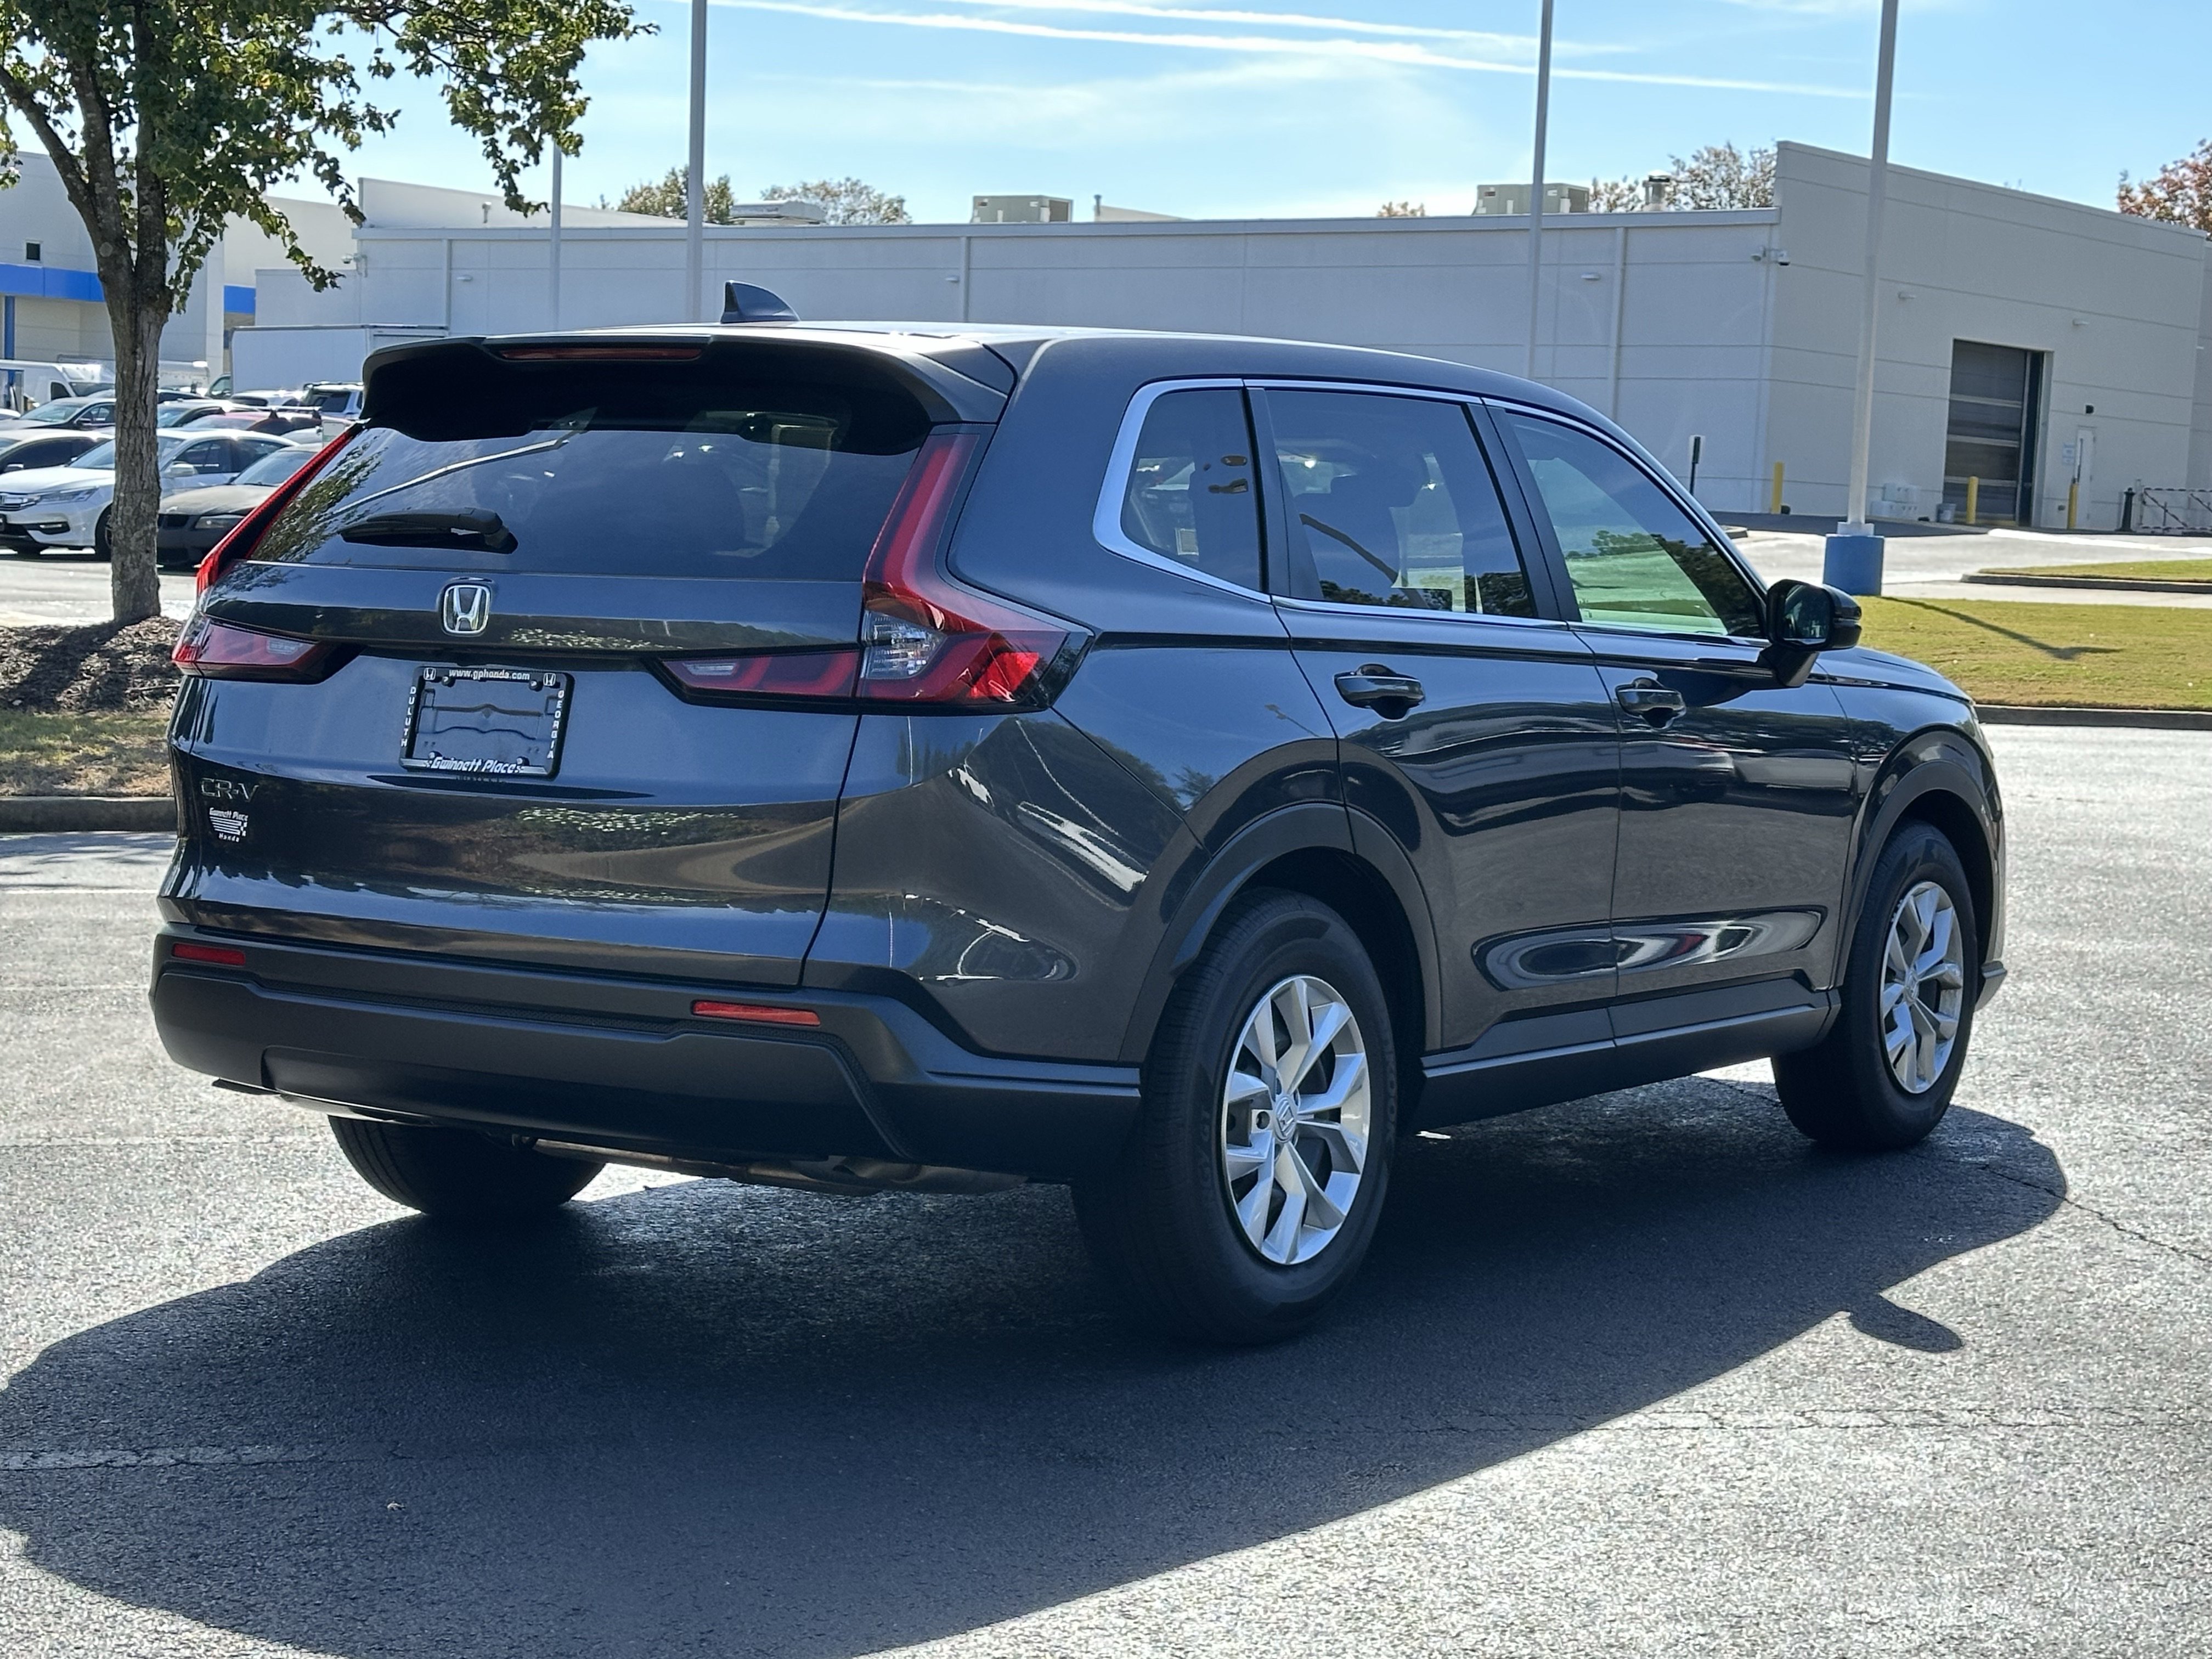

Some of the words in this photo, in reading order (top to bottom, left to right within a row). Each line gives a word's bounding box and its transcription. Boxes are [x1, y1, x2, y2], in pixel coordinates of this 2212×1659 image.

[449, 668, 530, 680] www.gphonda.com
[401, 686, 416, 747] DULUTH
[431, 757, 482, 772] Gwinnett
[482, 759, 517, 774] Place
[201, 777, 259, 803] CR-V
